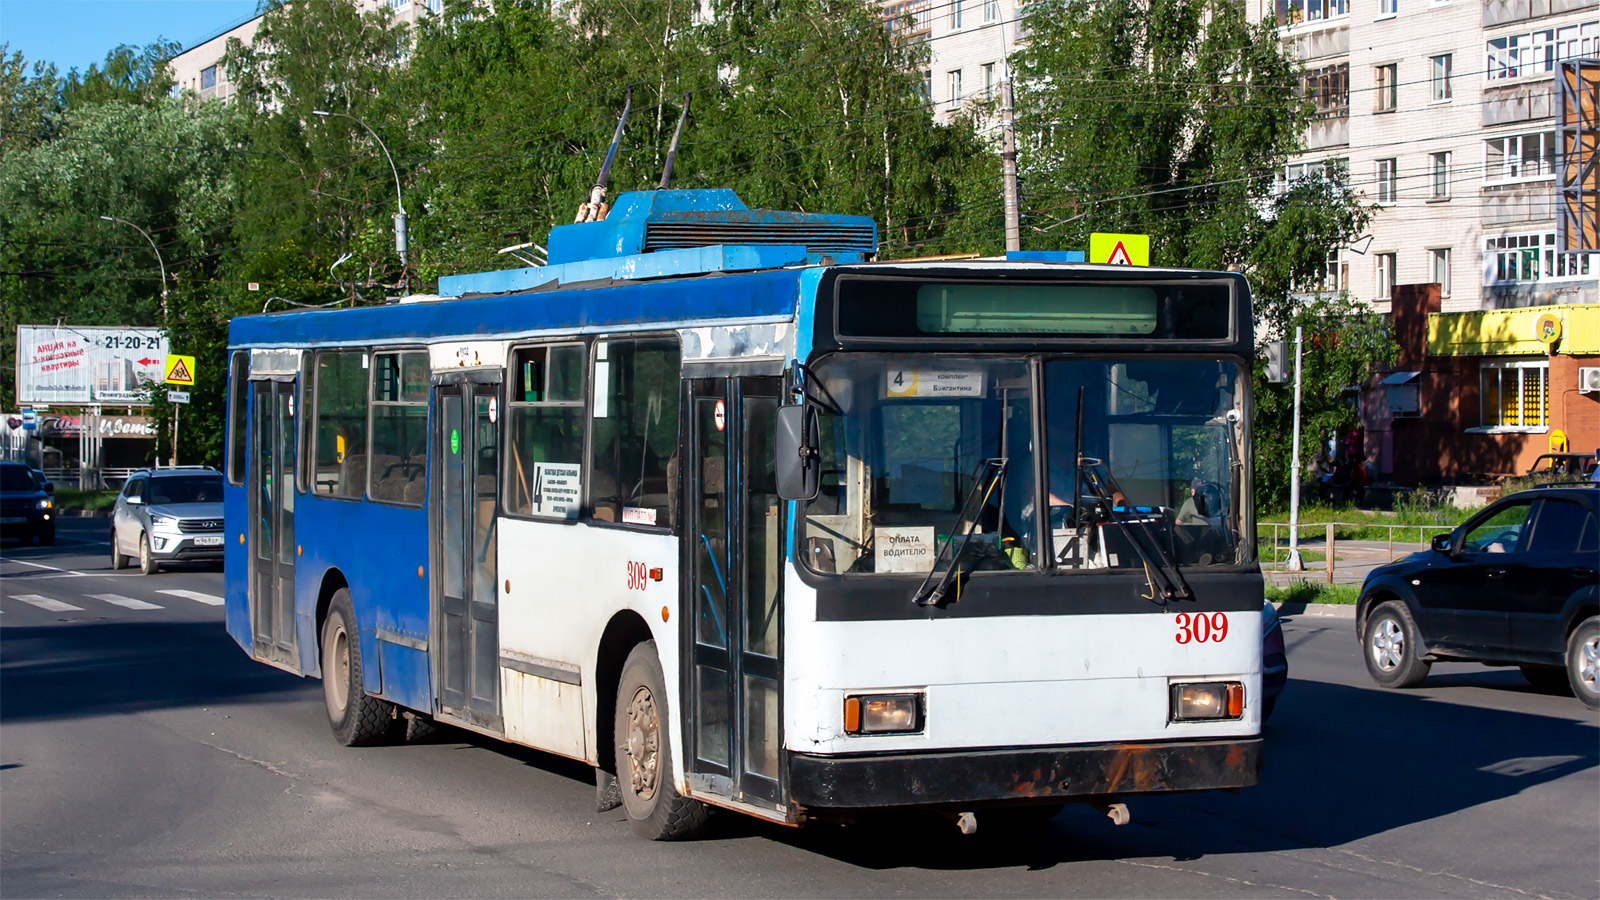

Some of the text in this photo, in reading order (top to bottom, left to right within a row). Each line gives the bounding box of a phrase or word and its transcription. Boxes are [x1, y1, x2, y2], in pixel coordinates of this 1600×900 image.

[37, 342, 64, 354] АКЦИЯ
[105, 336, 160, 350] 21-20-21
[41, 360, 80, 372] квартиры
[894, 371, 905, 387] 4
[533, 465, 543, 512] 4
[889, 536, 920, 544] ОПЛАТА
[884, 548, 927, 558] ВОДИТЕЛЮ
[1056, 537, 1083, 568] 4
[627, 560, 647, 591] 309
[1175, 611, 1228, 644] 309
